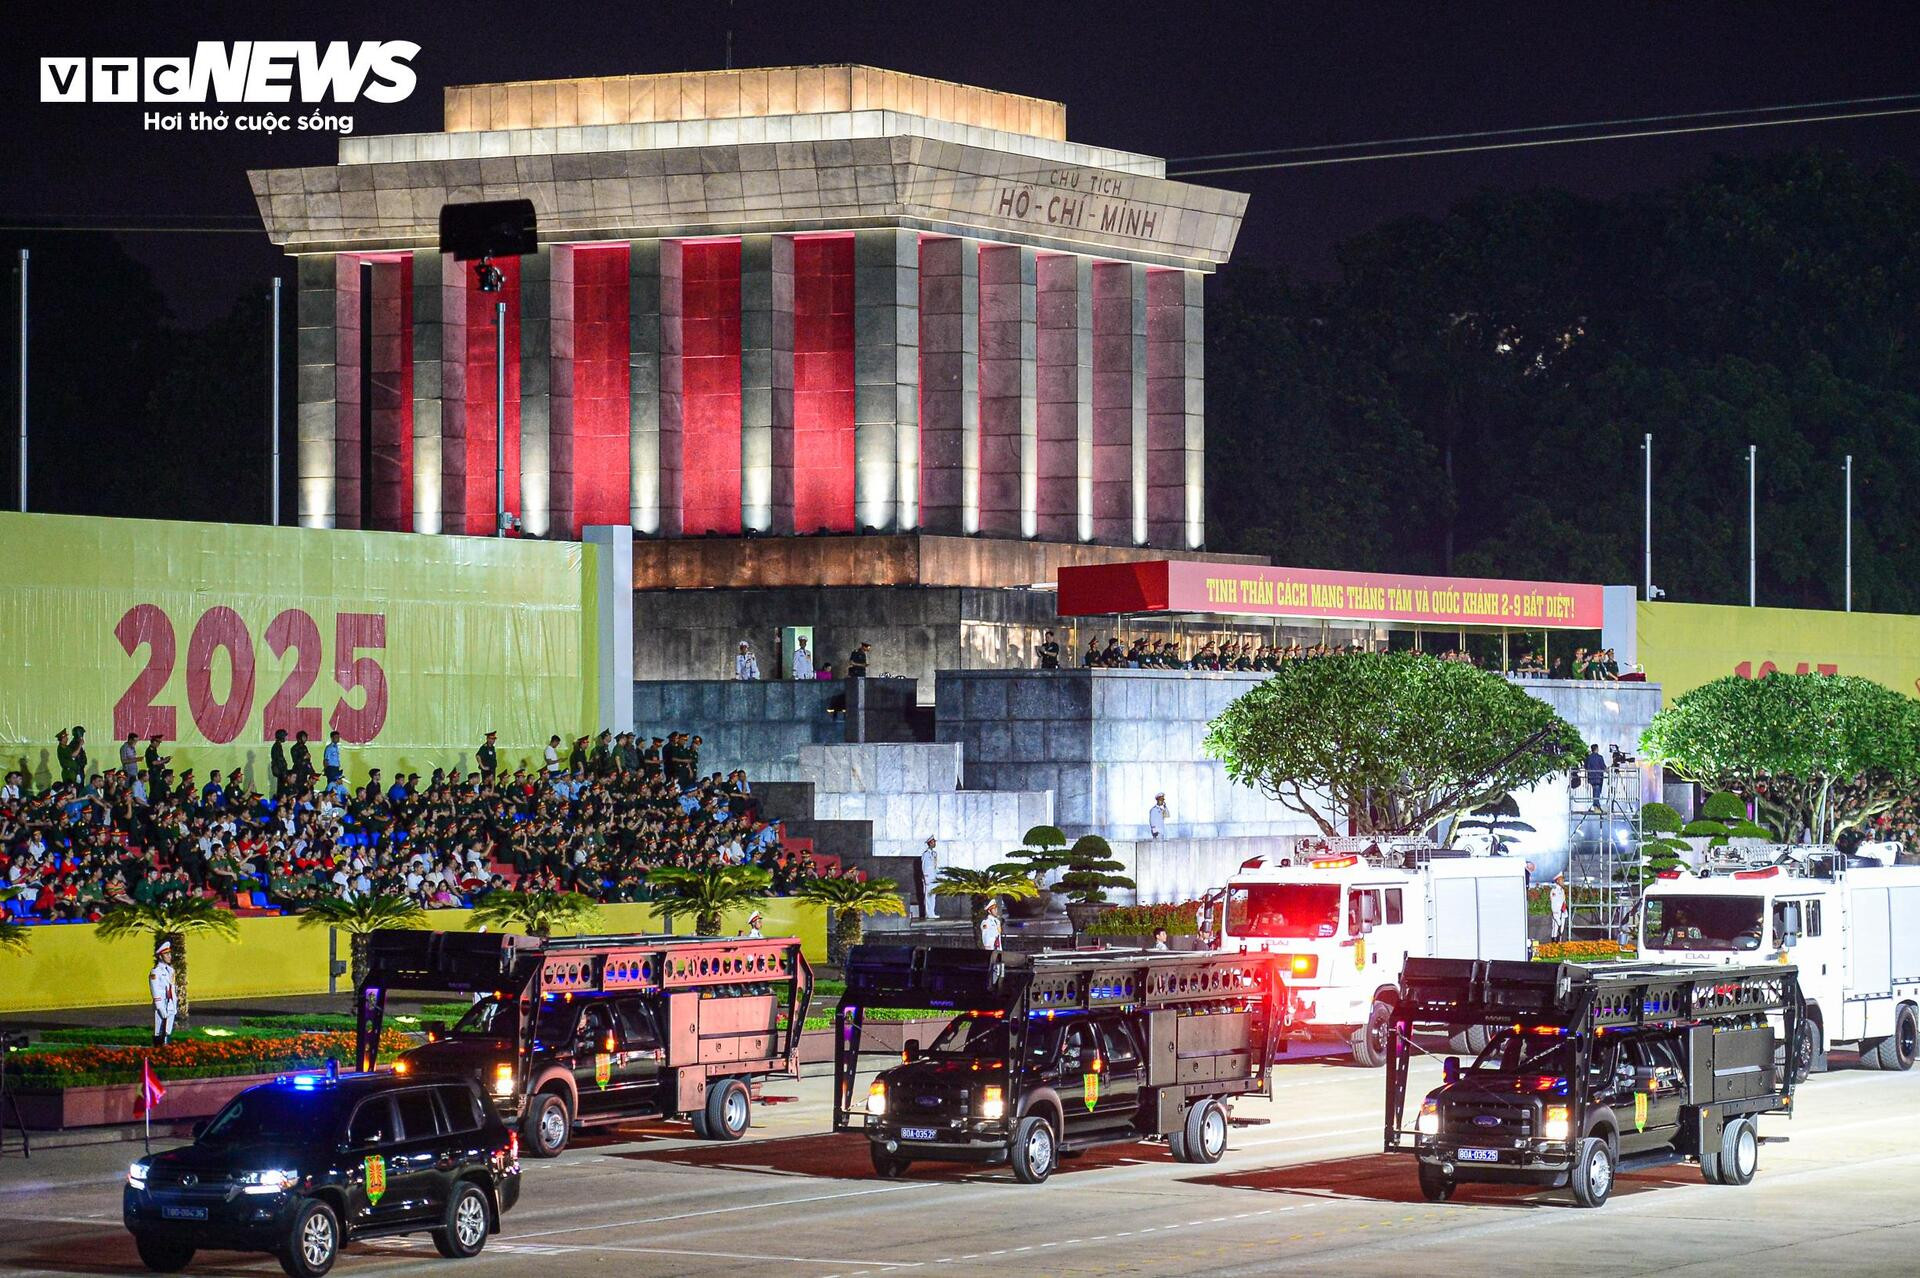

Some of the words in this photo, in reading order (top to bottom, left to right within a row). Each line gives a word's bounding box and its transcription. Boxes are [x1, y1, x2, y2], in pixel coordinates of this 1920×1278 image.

[1206, 578, 1237, 603] TINH
[1277, 577, 1308, 607] CÁCH
[1311, 584, 1344, 613] MẠNG
[1347, 582, 1386, 611] THÁNG
[1388, 585, 1412, 612] TÁM
[1415, 585, 1430, 613] VÀ
[1432, 585, 1460, 615] QUỐC
[1462, 588, 1499, 616] KHÁNH
[1501, 593, 1521, 617] 2-9
[1523, 588, 1544, 617] BẤT
[113, 603, 388, 745] 2025
